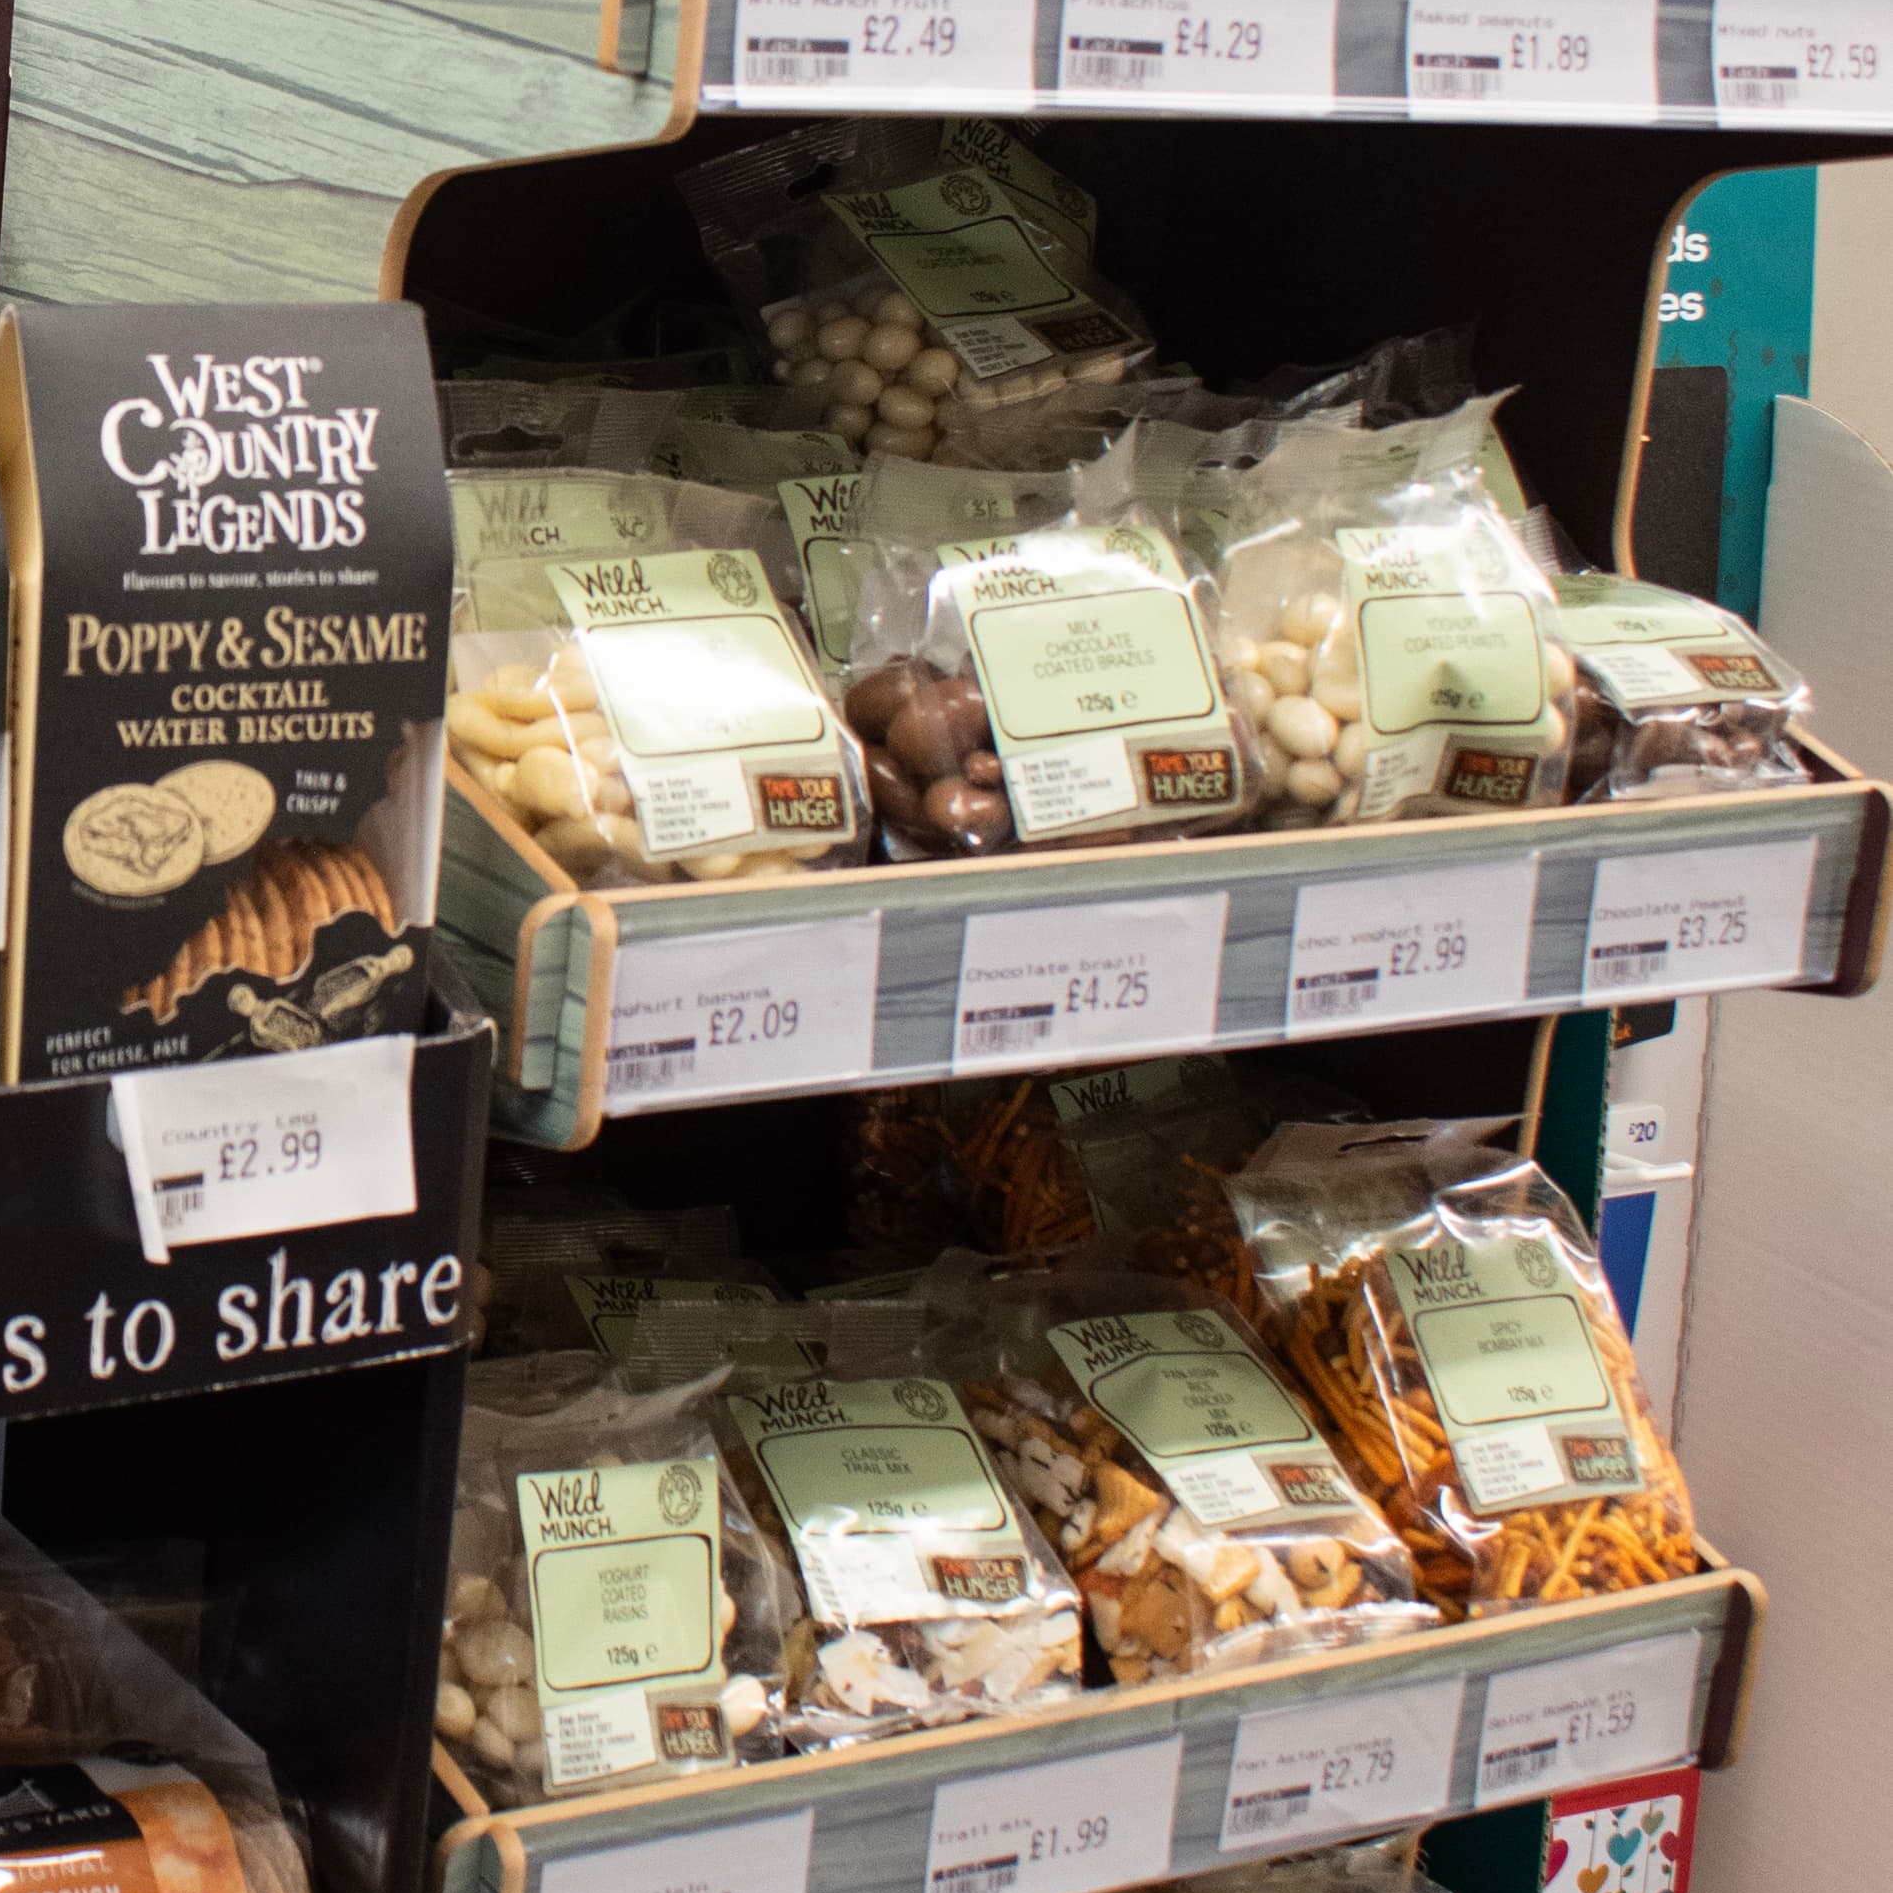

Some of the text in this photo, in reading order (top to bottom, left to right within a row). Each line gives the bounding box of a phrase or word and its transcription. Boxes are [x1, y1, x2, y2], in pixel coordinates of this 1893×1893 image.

[862, 16, 957, 57] £2.49
[1174, 18, 1264, 61] £4.29
[1511, 35, 1590, 72] £1.89
[1806, 44, 1878, 79] £2.59
[100, 397, 379, 489] COUNTRY
[137, 489, 366, 555] LEGENDS
[562, 557, 652, 597] Wild
[64, 606, 427, 677] POPPY & SESAME
[171, 680, 329, 712] COCKTAIL
[1075, 692, 1113, 713] 125g
[117, 712, 375, 747] WATER BISCUITS
[1153, 772, 1226, 800] HUNGER
[767, 798, 840, 828] HUNGER
[1677, 911, 1747, 947] £3.25
[1390, 937, 1466, 976] £2.99
[1064, 973, 1149, 1013] £4.25
[707, 1001, 798, 1047] £2.09
[1628, 1121, 1656, 1143] £20
[217, 1127, 323, 1184] £2.99
[1405, 1248, 1468, 1282] Wild
[81, 1290, 176, 1381] to
[214, 1245, 465, 1361] share
[530, 1472, 604, 1518] Wild
[597, 1565, 649, 1583] YOGHURT
[944, 1575, 1020, 1601] HUNGER
[601, 1585, 646, 1603] COATED
[606, 1645, 640, 1666] 125g
[1567, 1702, 1636, 1745] £1.59
[1320, 1752, 1395, 1791] £2.79
[1028, 1815, 1109, 1862] £1.99
